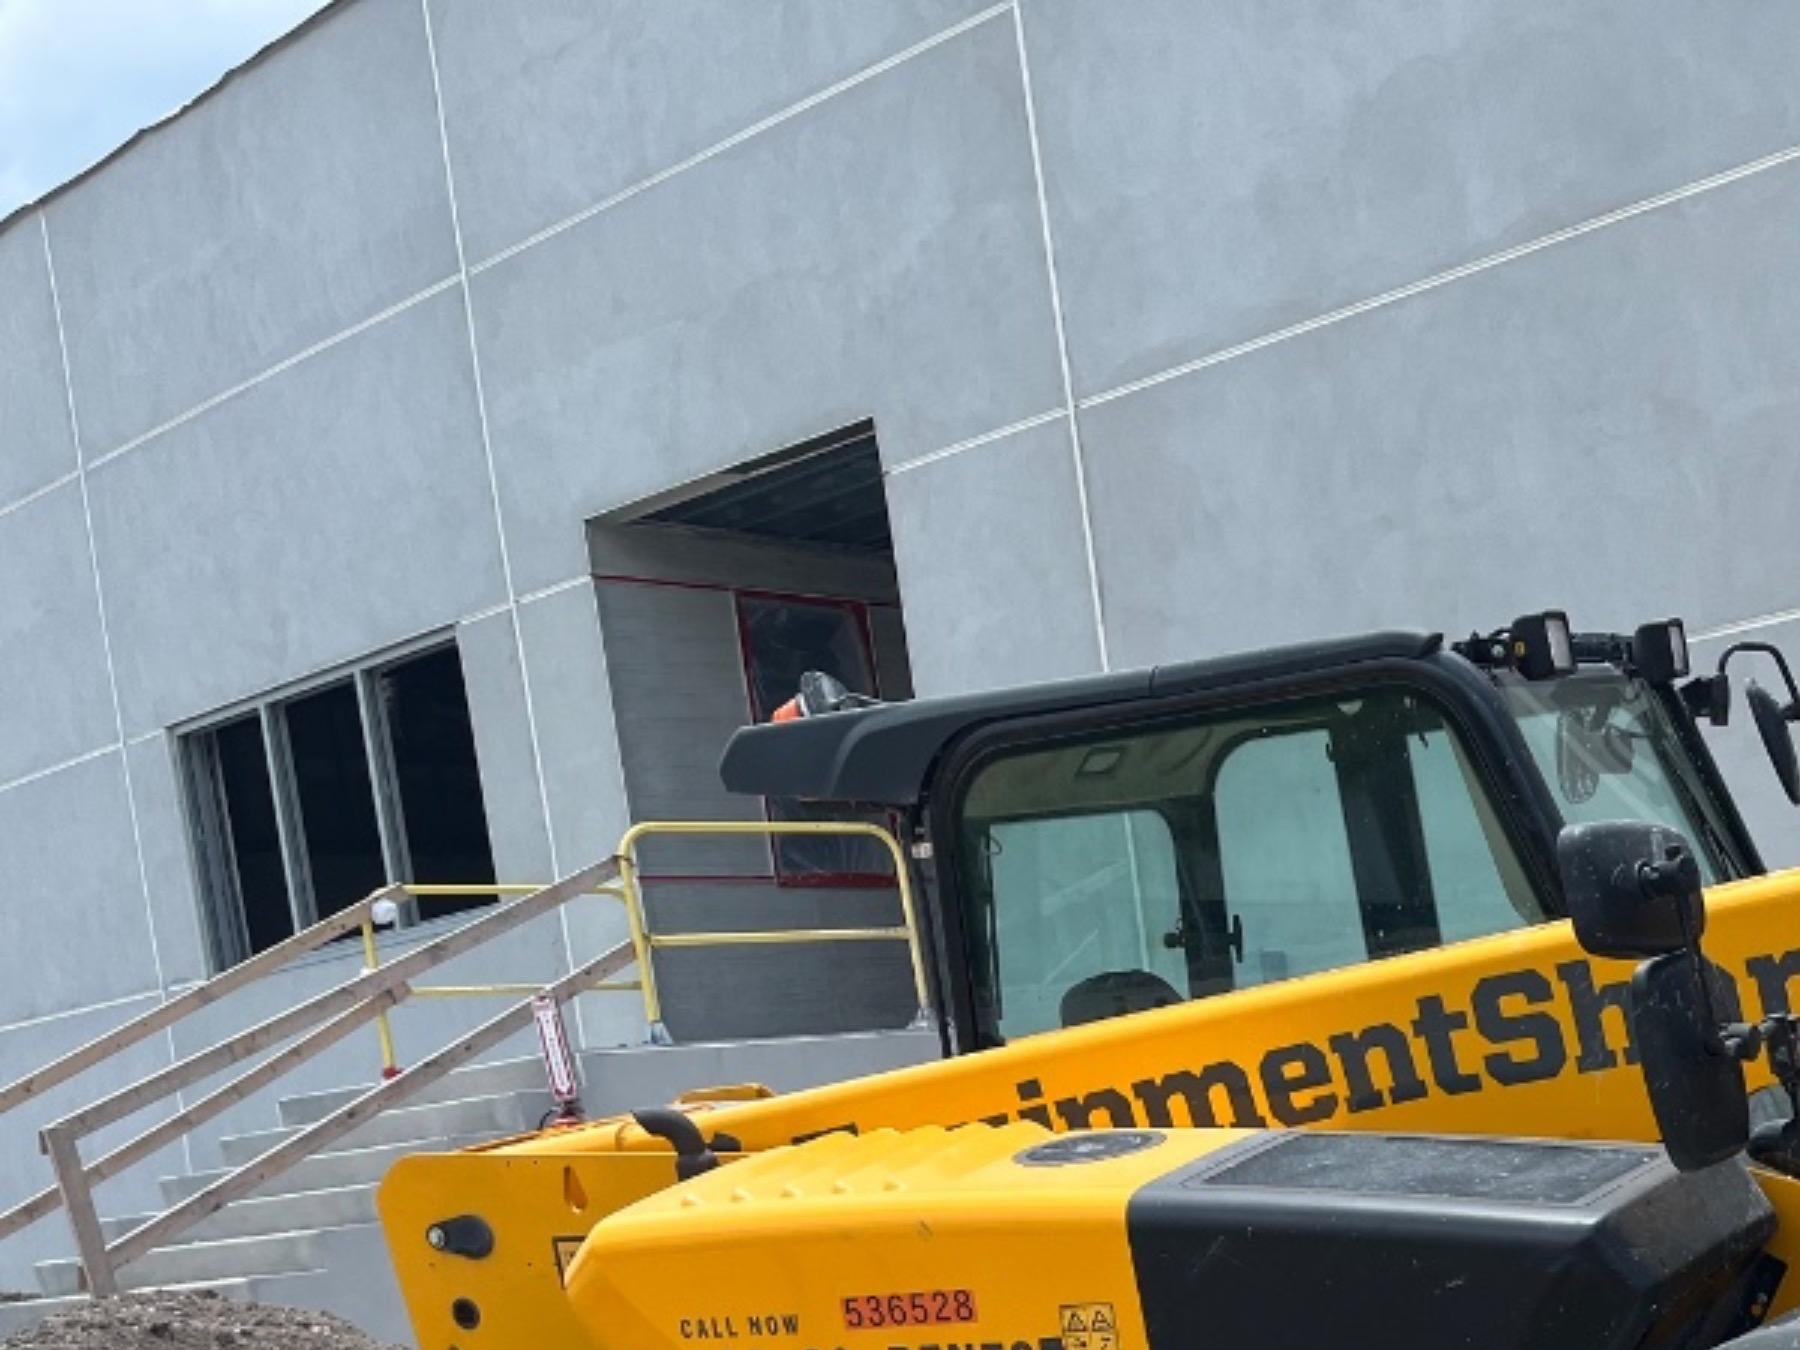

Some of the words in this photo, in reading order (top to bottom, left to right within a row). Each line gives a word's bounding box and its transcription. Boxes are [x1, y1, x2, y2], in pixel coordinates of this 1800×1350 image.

[846, 1290, 973, 1328] 536528
[680, 1317, 738, 1338] CALL
[748, 1314, 799, 1336] NOW
